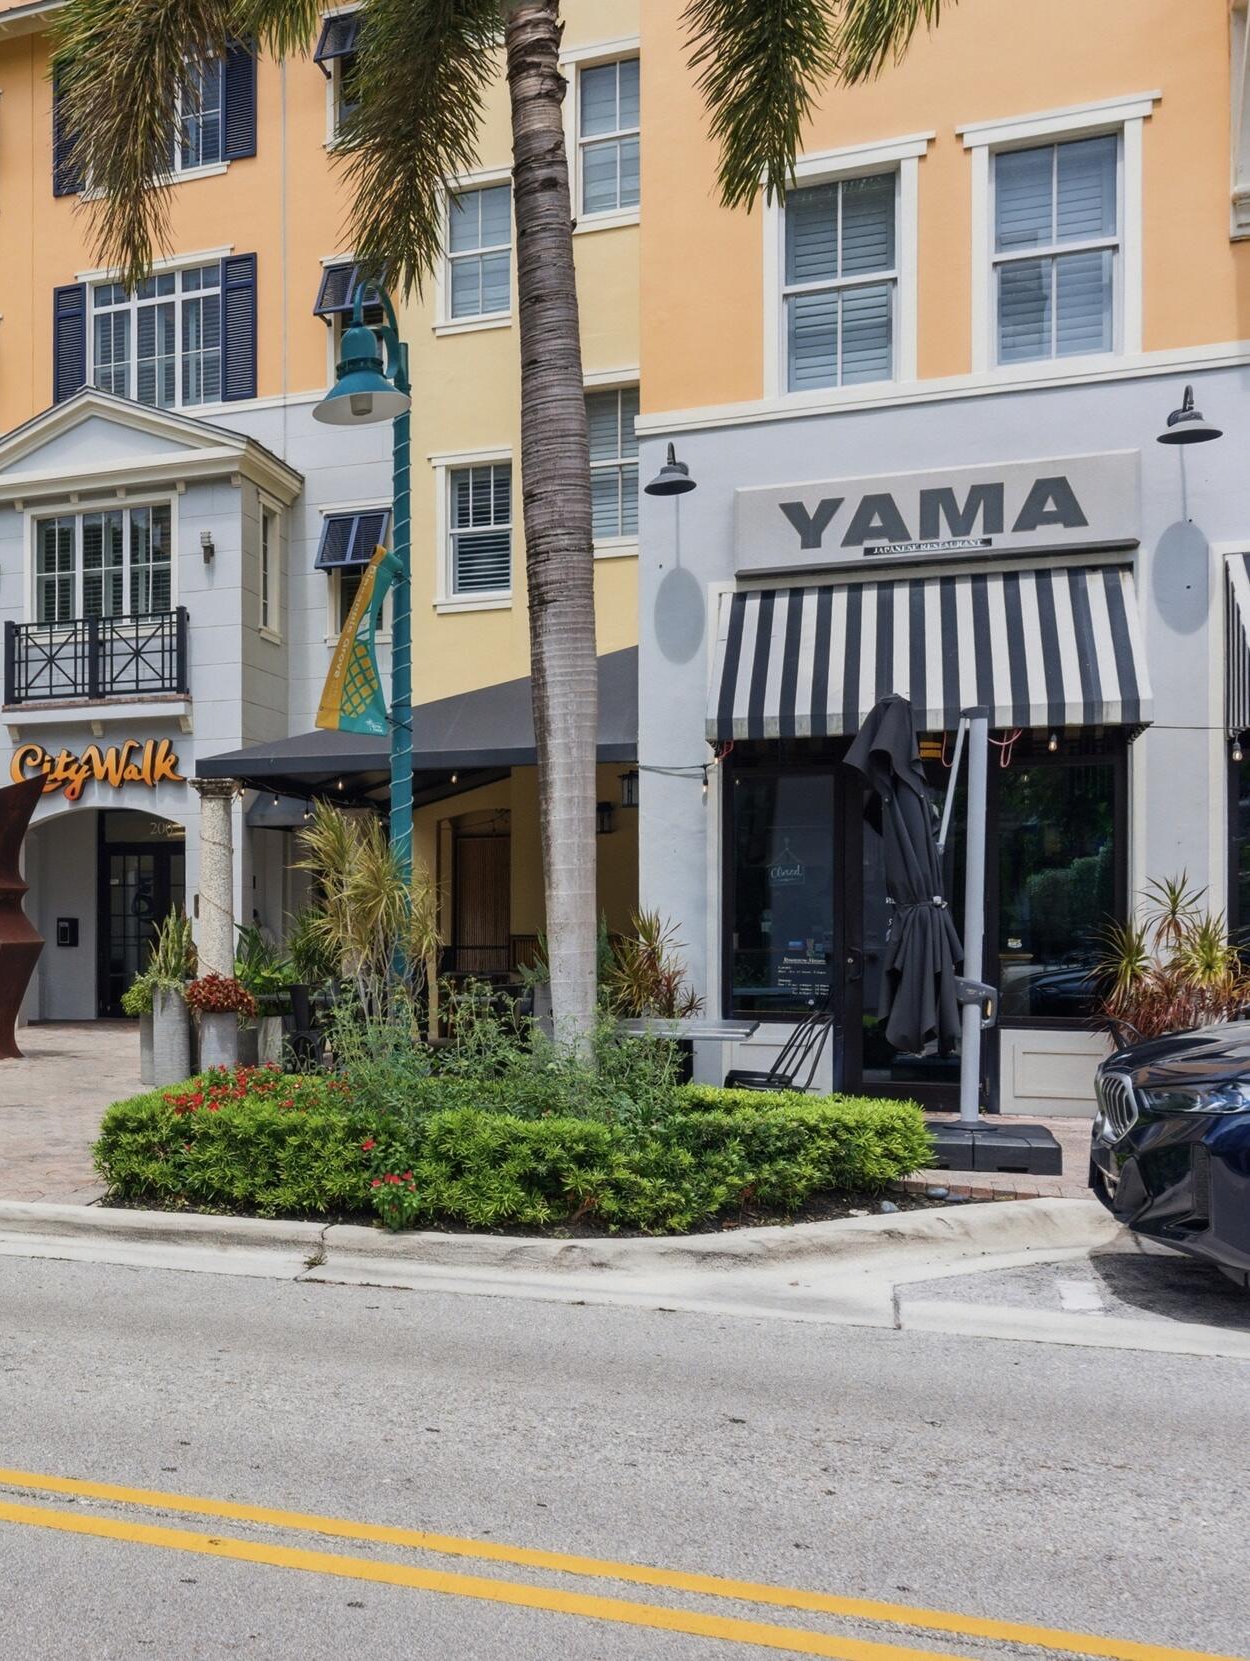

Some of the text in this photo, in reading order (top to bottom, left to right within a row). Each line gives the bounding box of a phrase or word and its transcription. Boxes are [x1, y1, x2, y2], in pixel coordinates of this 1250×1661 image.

[778, 476, 1089, 550] YAMA
[873, 539, 983, 555] JAPANESE RESTAURANT
[10, 737, 187, 801] CityWalk
